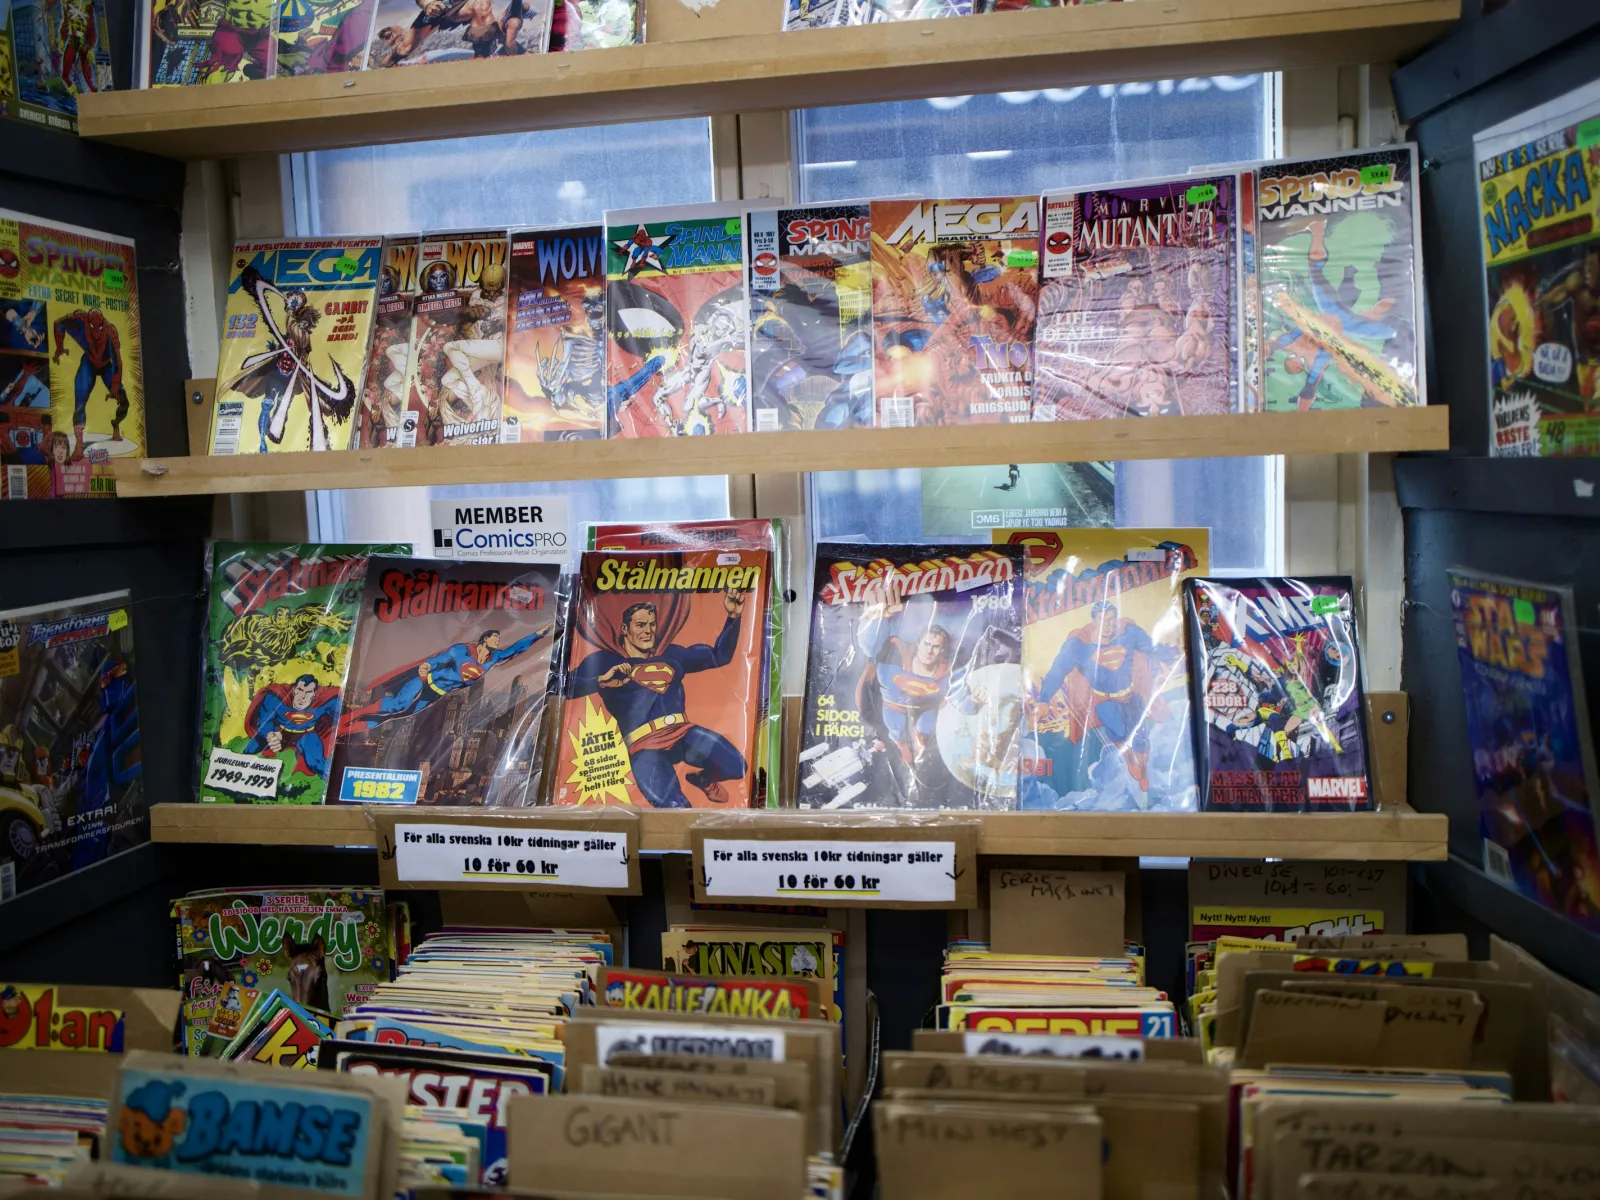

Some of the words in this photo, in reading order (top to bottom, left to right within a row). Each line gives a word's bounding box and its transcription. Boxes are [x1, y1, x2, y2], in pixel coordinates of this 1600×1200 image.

[19, 108, 46, 123] SVERIGES
[1260, 192, 1402, 221] MANNEN
[1485, 150, 1592, 259] NACKA
[885, 201, 1040, 245] MEGA
[252, 242, 302, 251] AVSLUTADE
[937, 235, 992, 243] MARVEL
[228, 247, 383, 294] MEGA
[27, 284, 52, 300] EXTRA
[54, 288, 80, 305] SECRET
[324, 300, 369, 316] GAMBIT
[417, 301, 443, 313] OMEGA
[444, 297, 462, 309] RED!
[228, 313, 259, 330] 132
[455, 505, 544, 525] MEMBER
[455, 528, 567, 549] ComicsPRO
[457, 549, 479, 557] Comics
[479, 548, 513, 557] Professional
[513, 548, 530, 556] Retail
[531, 547, 568, 557] Organization
[596, 558, 762, 592] Stålmannen
[375, 569, 545, 623] Stålmannen
[1211, 681, 1237, 693] 238
[817, 693, 836, 707] 64
[1203, 696, 1248, 708] SIDOR!
[816, 709, 861, 722] SIDOR
[823, 721, 865, 738] FÄRG!
[581, 730, 615, 748] JÄTTE
[583, 741, 616, 756] ALBUM
[584, 758, 596, 767] 68
[596, 753, 618, 765] sidor
[346, 770, 418, 783] PRESENTALBUM
[579, 760, 626, 778] spännande
[586, 769, 620, 783] äventyr
[210, 768, 275, 789] 1949-1979
[584, 782, 601, 793] helt
[606, 777, 625, 787] färg
[1212, 770, 1276, 788] MASSOR
[1281, 770, 1302, 787] AV
[352, 780, 405, 800] 1982
[1212, 787, 1306, 804] MUTANTER!
[1308, 778, 1365, 798] MARVEL
[67, 803, 118, 827] EXTRA!
[82, 820, 104, 831] VINN
[403, 831, 422, 844] För
[426, 833, 446, 845] alla
[449, 834, 492, 846] svenska
[497, 835, 524, 848] 10kr
[527, 836, 580, 850] tidningar
[583, 838, 617, 851] gäller
[713, 850, 733, 862] För
[737, 850, 758, 862] alla
[761, 850, 808, 862] svenska
[813, 850, 842, 862] 10kr
[846, 850, 903, 864] tidningar
[907, 850, 943, 864] gäller
[463, 857, 482, 872] 10
[487, 857, 511, 873] för
[516, 859, 536, 874] 60
[541, 860, 559, 875] kr
[778, 874, 797, 889] 10
[803, 874, 828, 889] för
[834, 874, 855, 889] 60
[861, 875, 880, 890] kr
[274, 895, 309, 905] SERIER!
[234, 907, 259, 916] SIDOR
[261, 906, 277, 914] MED
[325, 905, 348, 914] EMMA
[1199, 912, 1223, 924] Nytt!
[1224, 913, 1247, 924] Nytt!
[1249, 914, 1271, 925] Nytt!
[208, 898, 362, 973] Wendy
[190, 997, 218, 1016] post
[1147, 1016, 1171, 1039] 21
[176, 1089, 362, 1169] BAMSE
[563, 1104, 681, 1148] GIGANT
